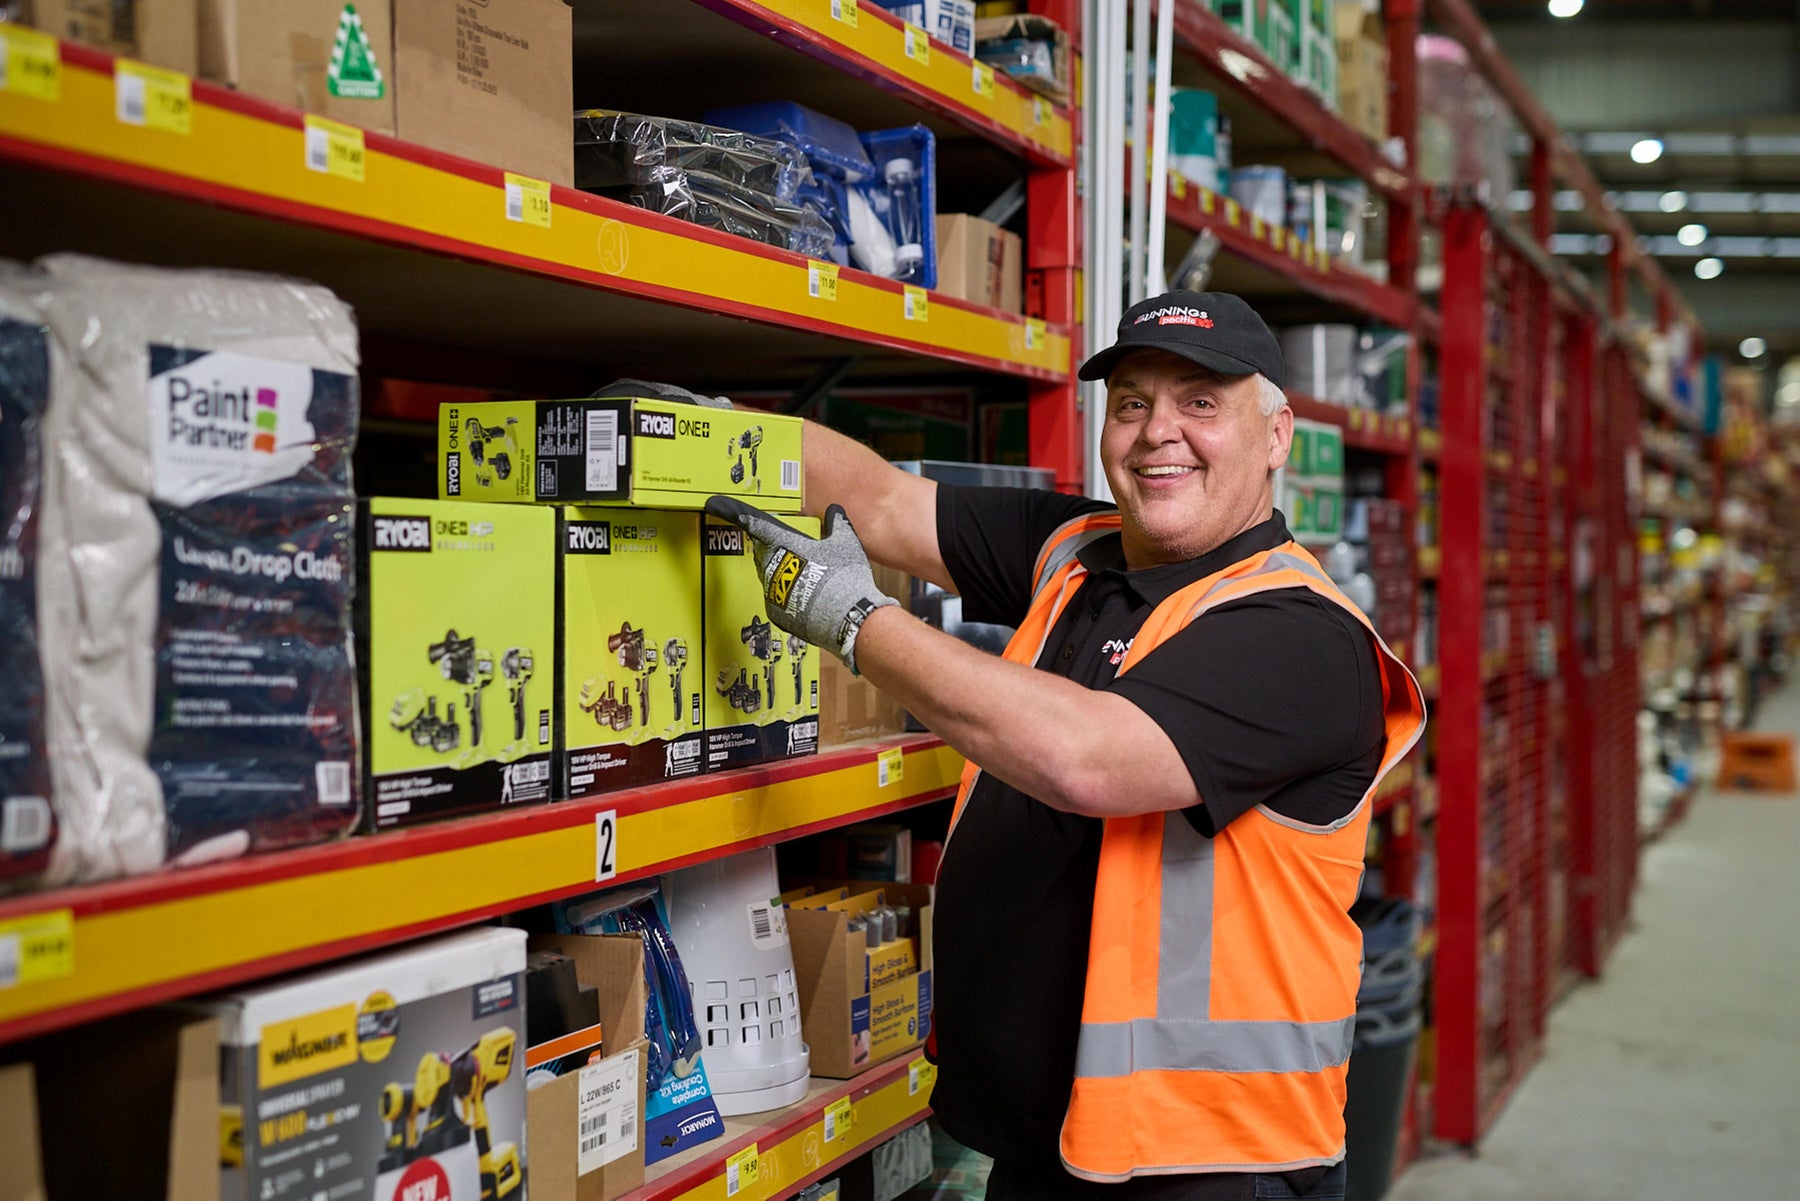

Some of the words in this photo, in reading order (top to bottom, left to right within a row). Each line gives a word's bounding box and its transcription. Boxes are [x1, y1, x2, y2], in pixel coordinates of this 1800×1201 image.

[1161, 315, 1196, 326] pacific
[168, 377, 249, 422] Paint
[169, 416, 247, 451] Partner
[641, 414, 675, 436] RYOBI
[448, 454, 460, 494] RYOBI
[375, 519, 430, 547] RYOBI
[569, 526, 609, 549] RYOBI
[639, 527, 657, 540] HP
[709, 530, 742, 551] RYOBI
[231, 546, 293, 583] Drop
[294, 551, 342, 582] Cloth
[601, 819, 612, 874] 2
[872, 962, 885, 975] High
[872, 973, 895, 989] Smooth
[872, 1004, 885, 1016] High
[886, 998, 900, 1009] Gloss
[872, 1012, 893, 1026] Smooth
[894, 1003, 916, 1017] Surfaces
[615, 1079, 621, 1090] C
[660, 1088, 671, 1098] Kit
[671, 1074, 703, 1092] Caulking
[672, 1086, 706, 1105] Complete
[681, 1115, 716, 1136] MONARCH
[402, 1174, 438, 1201] NEW
